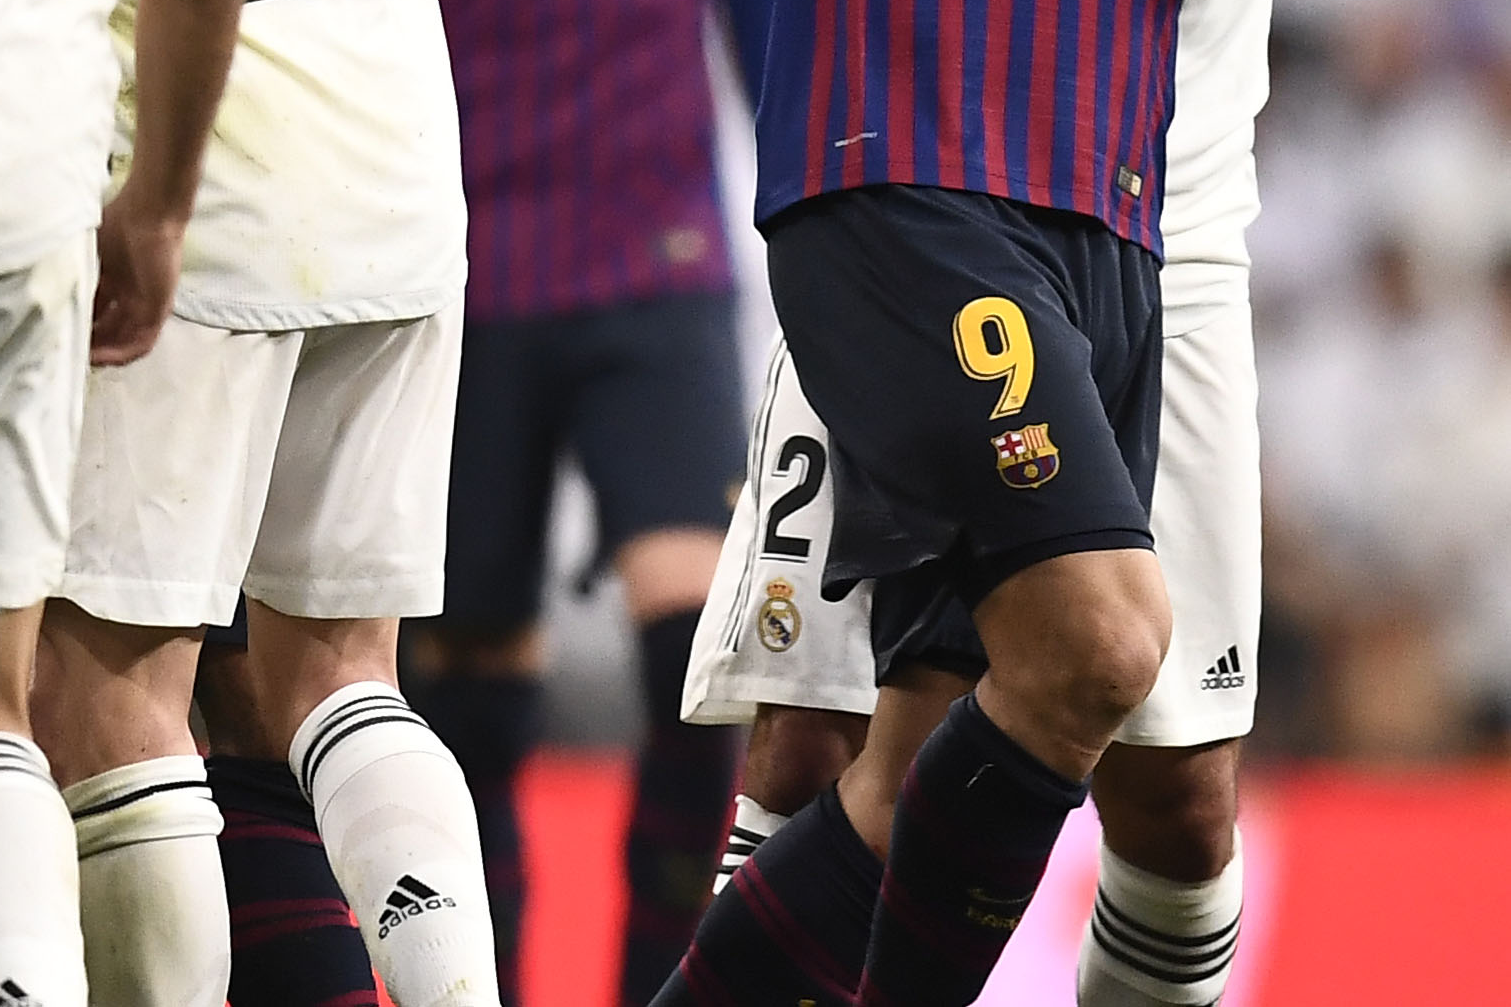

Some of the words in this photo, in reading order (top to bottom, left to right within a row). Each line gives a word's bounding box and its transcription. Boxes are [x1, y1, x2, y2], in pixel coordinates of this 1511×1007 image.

[952, 296, 1035, 421] 9
[760, 435, 826, 564] 2
[378, 897, 456, 940] adidas
